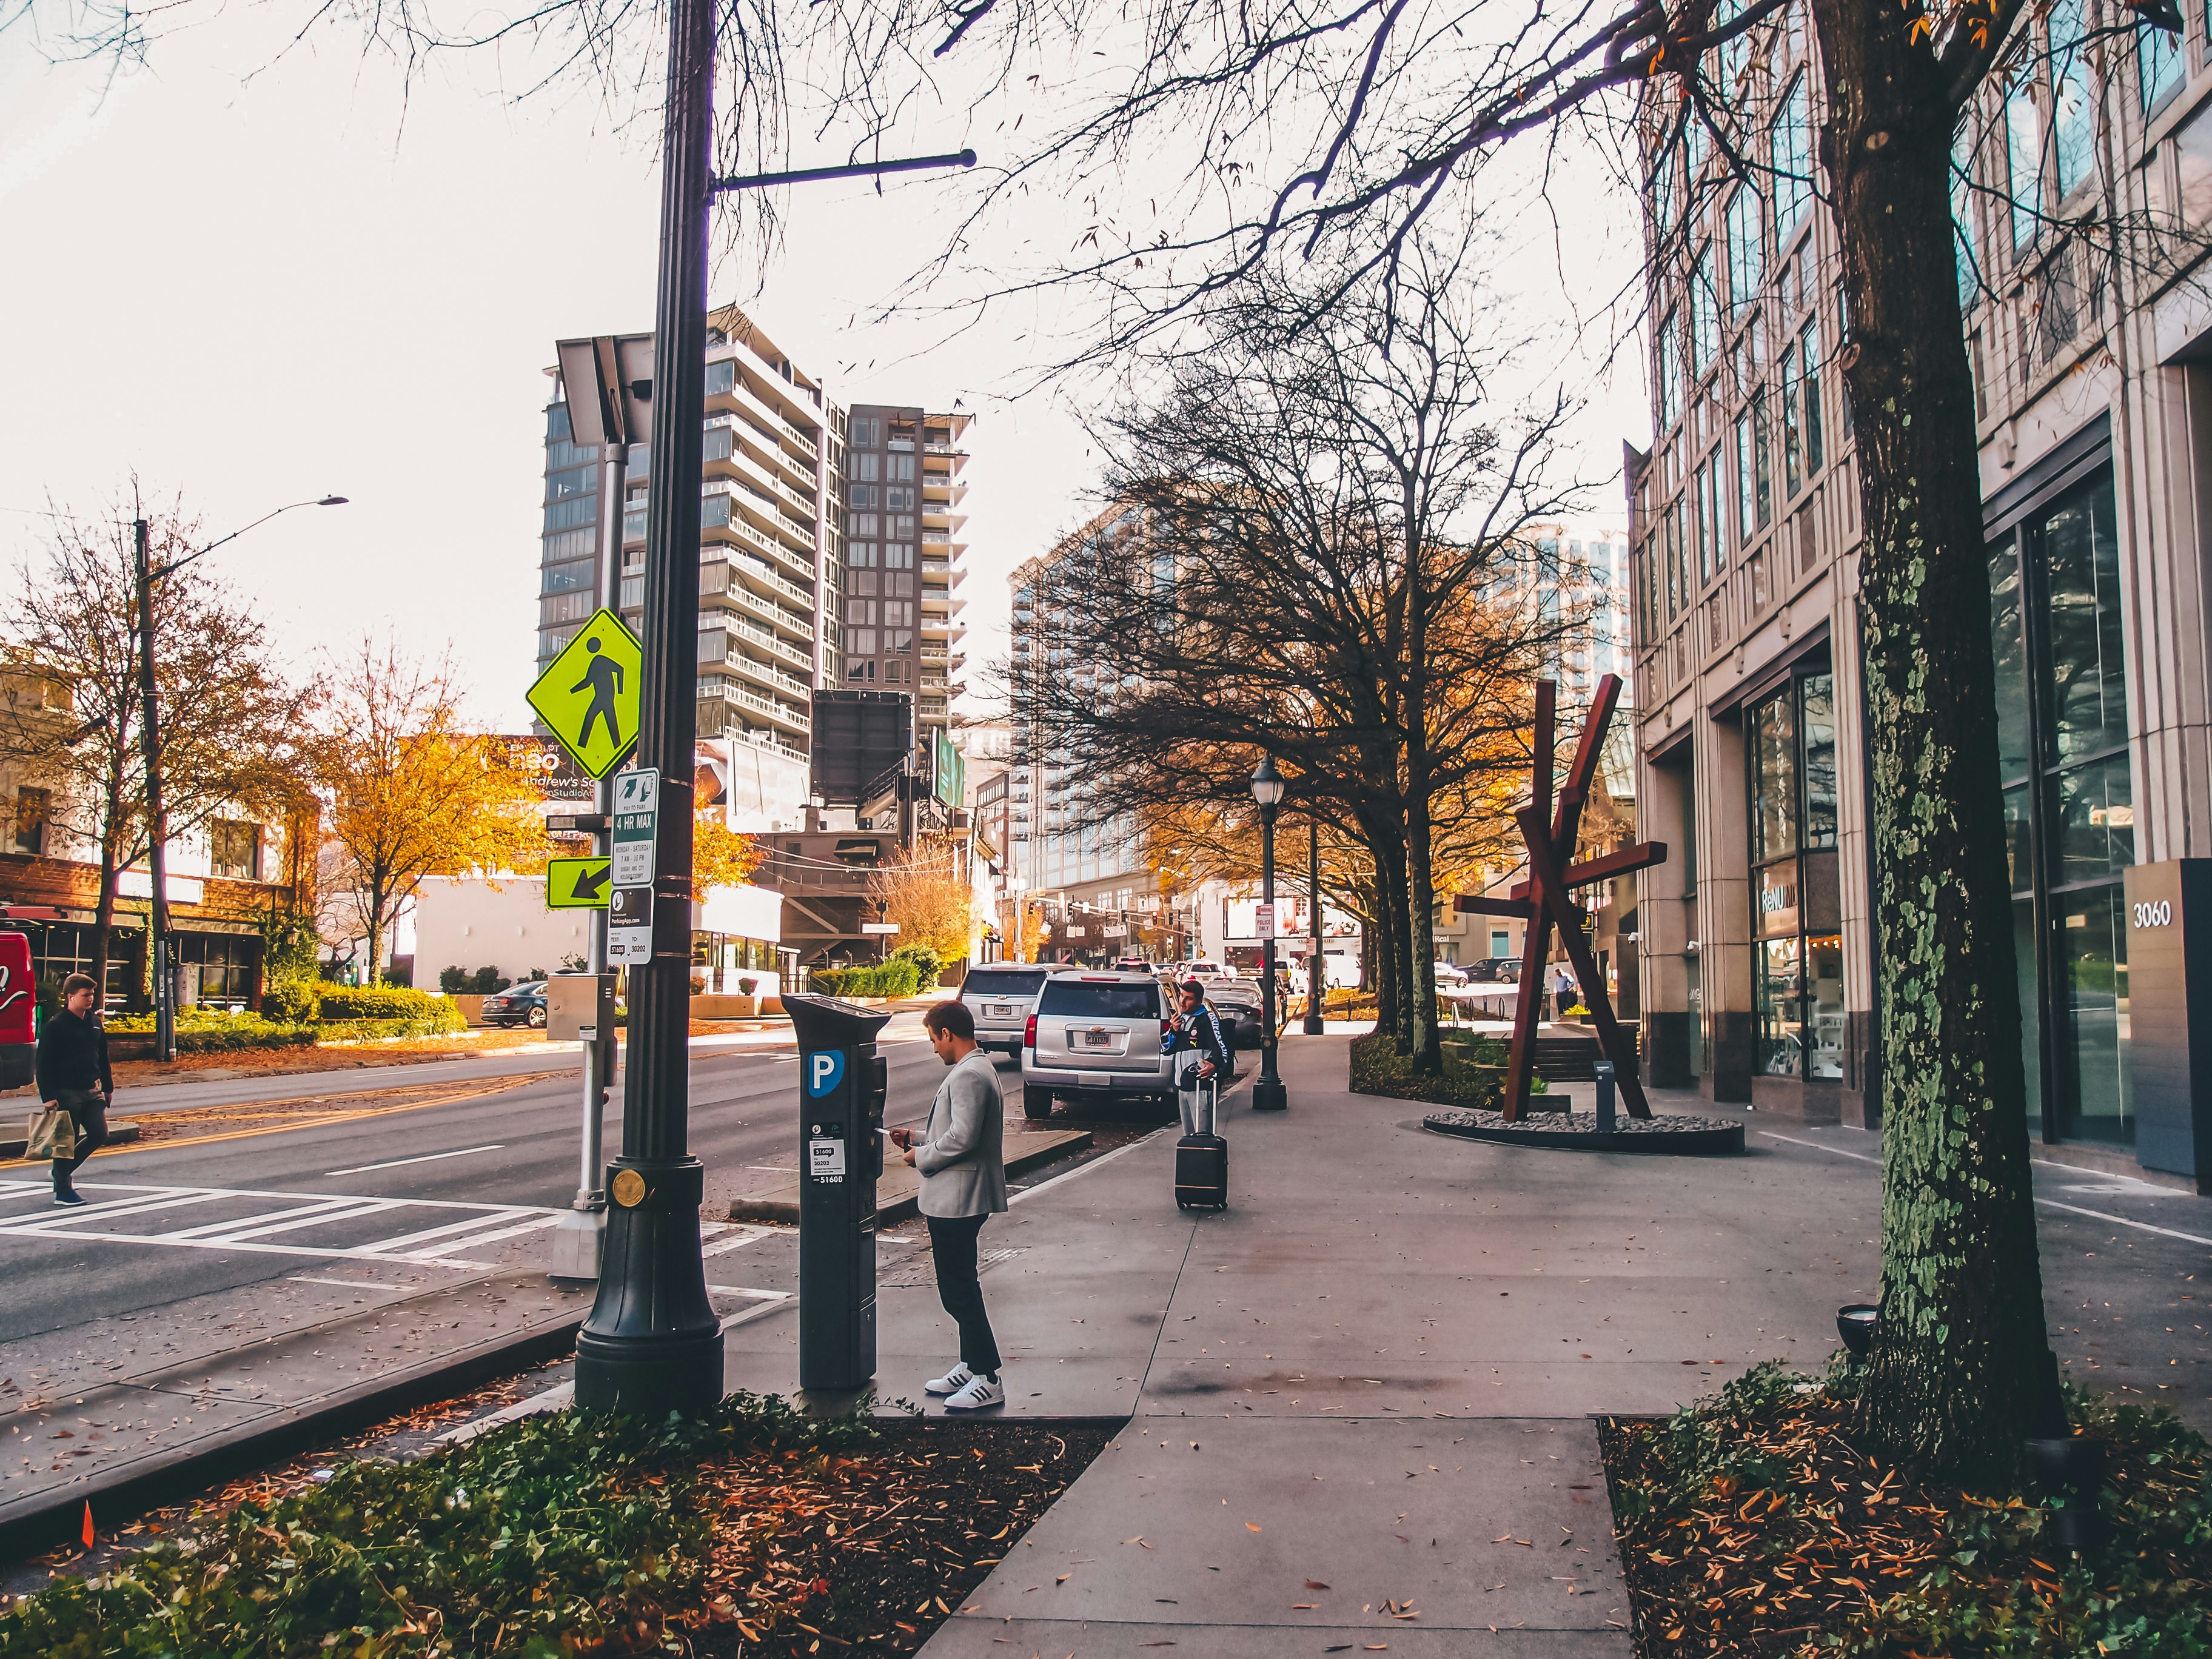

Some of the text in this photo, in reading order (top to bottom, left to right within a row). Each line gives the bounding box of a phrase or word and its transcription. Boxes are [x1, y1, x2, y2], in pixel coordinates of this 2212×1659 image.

[617, 813, 652, 831] 4 HR MAX
[2133, 900, 2173, 928] 3060
[814, 1055, 834, 1089] P
